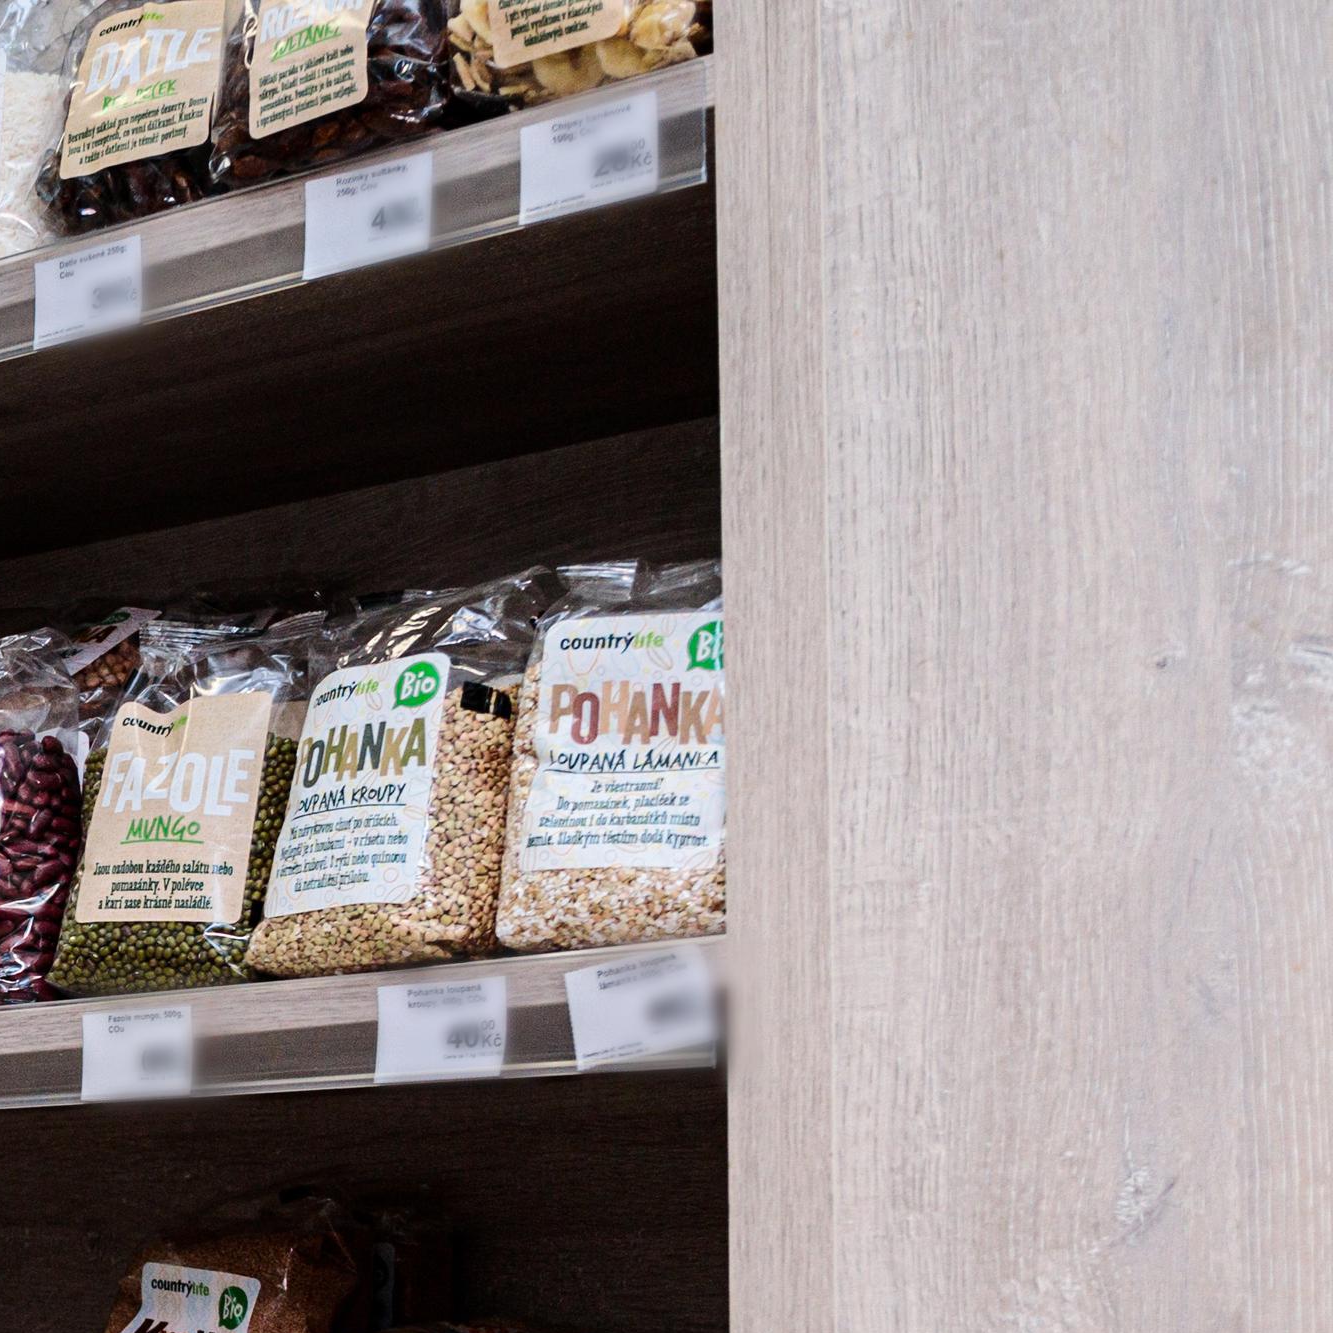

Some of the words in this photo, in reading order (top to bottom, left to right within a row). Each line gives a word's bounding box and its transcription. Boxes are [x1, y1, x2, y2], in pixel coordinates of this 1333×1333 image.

[85, 26, 221, 95] DATLE
[560, 632, 665, 654] countrylife
[400, 669, 437, 699] Bio
[548, 680, 724, 745] POHANKA
[296, 717, 427, 789] POHANKA
[549, 750, 627, 774] LOUPANÁ
[633, 750, 719, 771] LÁMANKA
[102, 748, 255, 817] FAZOLE
[295, 784, 346, 814] OUPANÁ
[351, 783, 407, 805] KROUPY
[126, 815, 201, 841] MUNGO
[93, 862, 111, 876] Jsou
[112, 859, 144, 875] ozdobou
[146, 859, 181, 874] každého
[183, 859, 210, 874] salátu
[212, 861, 234, 876] nebo
[110, 878, 160, 896] pomazánky.
[171, 877, 205, 895] polévce
[151, 1278, 210, 1298] countrylife
[223, 1293, 244, 1320] Bio
